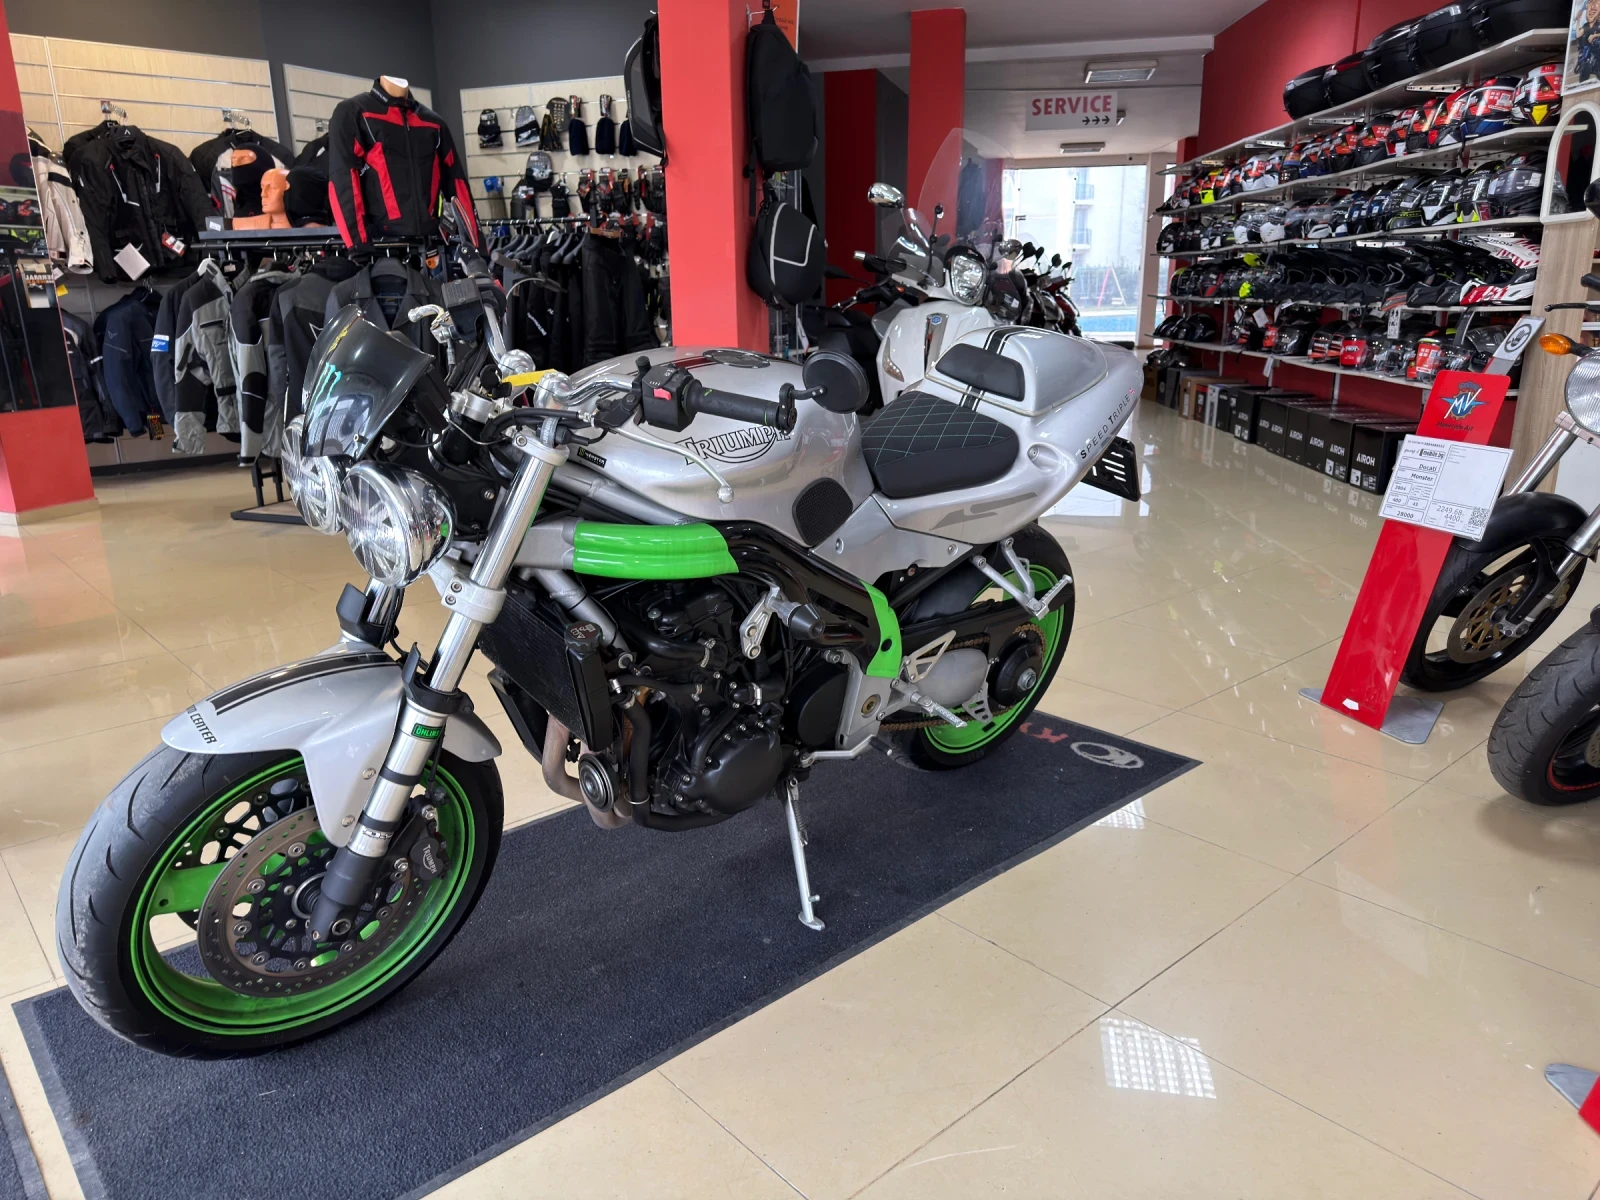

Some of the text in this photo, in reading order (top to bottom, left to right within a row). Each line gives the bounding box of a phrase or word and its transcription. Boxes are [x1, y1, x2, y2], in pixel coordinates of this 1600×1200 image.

[1032, 95, 1112, 116] SERVICE
[1444, 387, 1482, 419] MV
[1080, 394, 1131, 459] SPEED TRIPLE
[1271, 424, 1283, 435] AIROH
[1289, 430, 1303, 441] AIROH
[1309, 436, 1325, 449] AIROH
[1330, 444, 1345, 457] AIROH
[1356, 452, 1376, 467] AIROH
[1419, 463, 1438, 472] Ducati
[1410, 472, 1434, 482] Monster
[1444, 513, 1461, 522] 4400
[190, 713, 218, 744] CENTER
[422, 843, 438, 874] TRIUMPH
